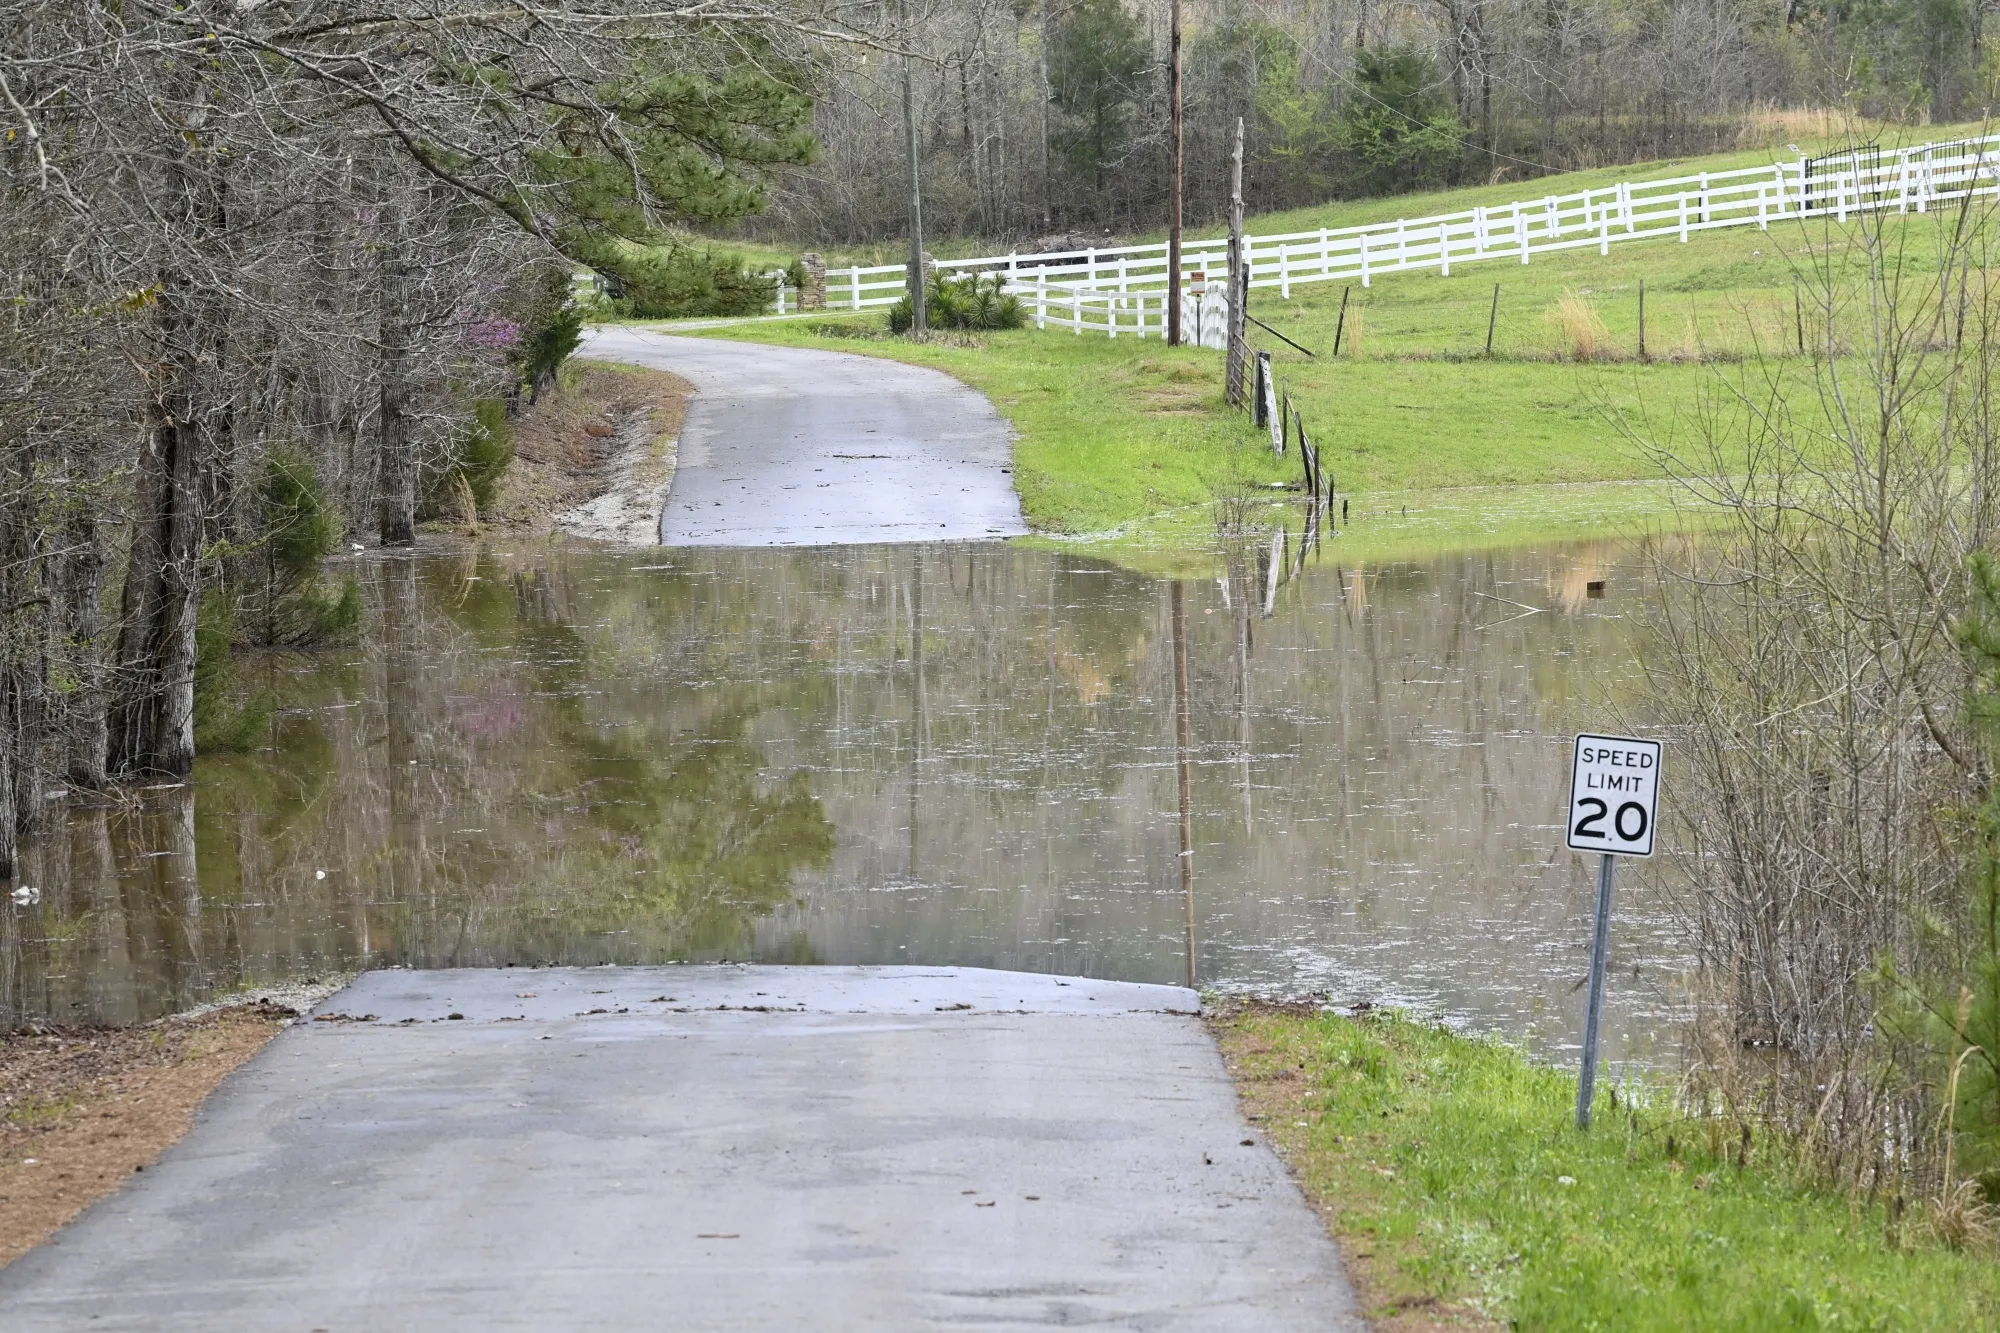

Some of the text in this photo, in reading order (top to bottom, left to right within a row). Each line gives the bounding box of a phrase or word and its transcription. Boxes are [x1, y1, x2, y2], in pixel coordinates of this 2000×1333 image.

[1582, 748, 1653, 769] SPEED
[1587, 773, 1643, 792] LIMIT
[1574, 797, 1648, 842] 20
